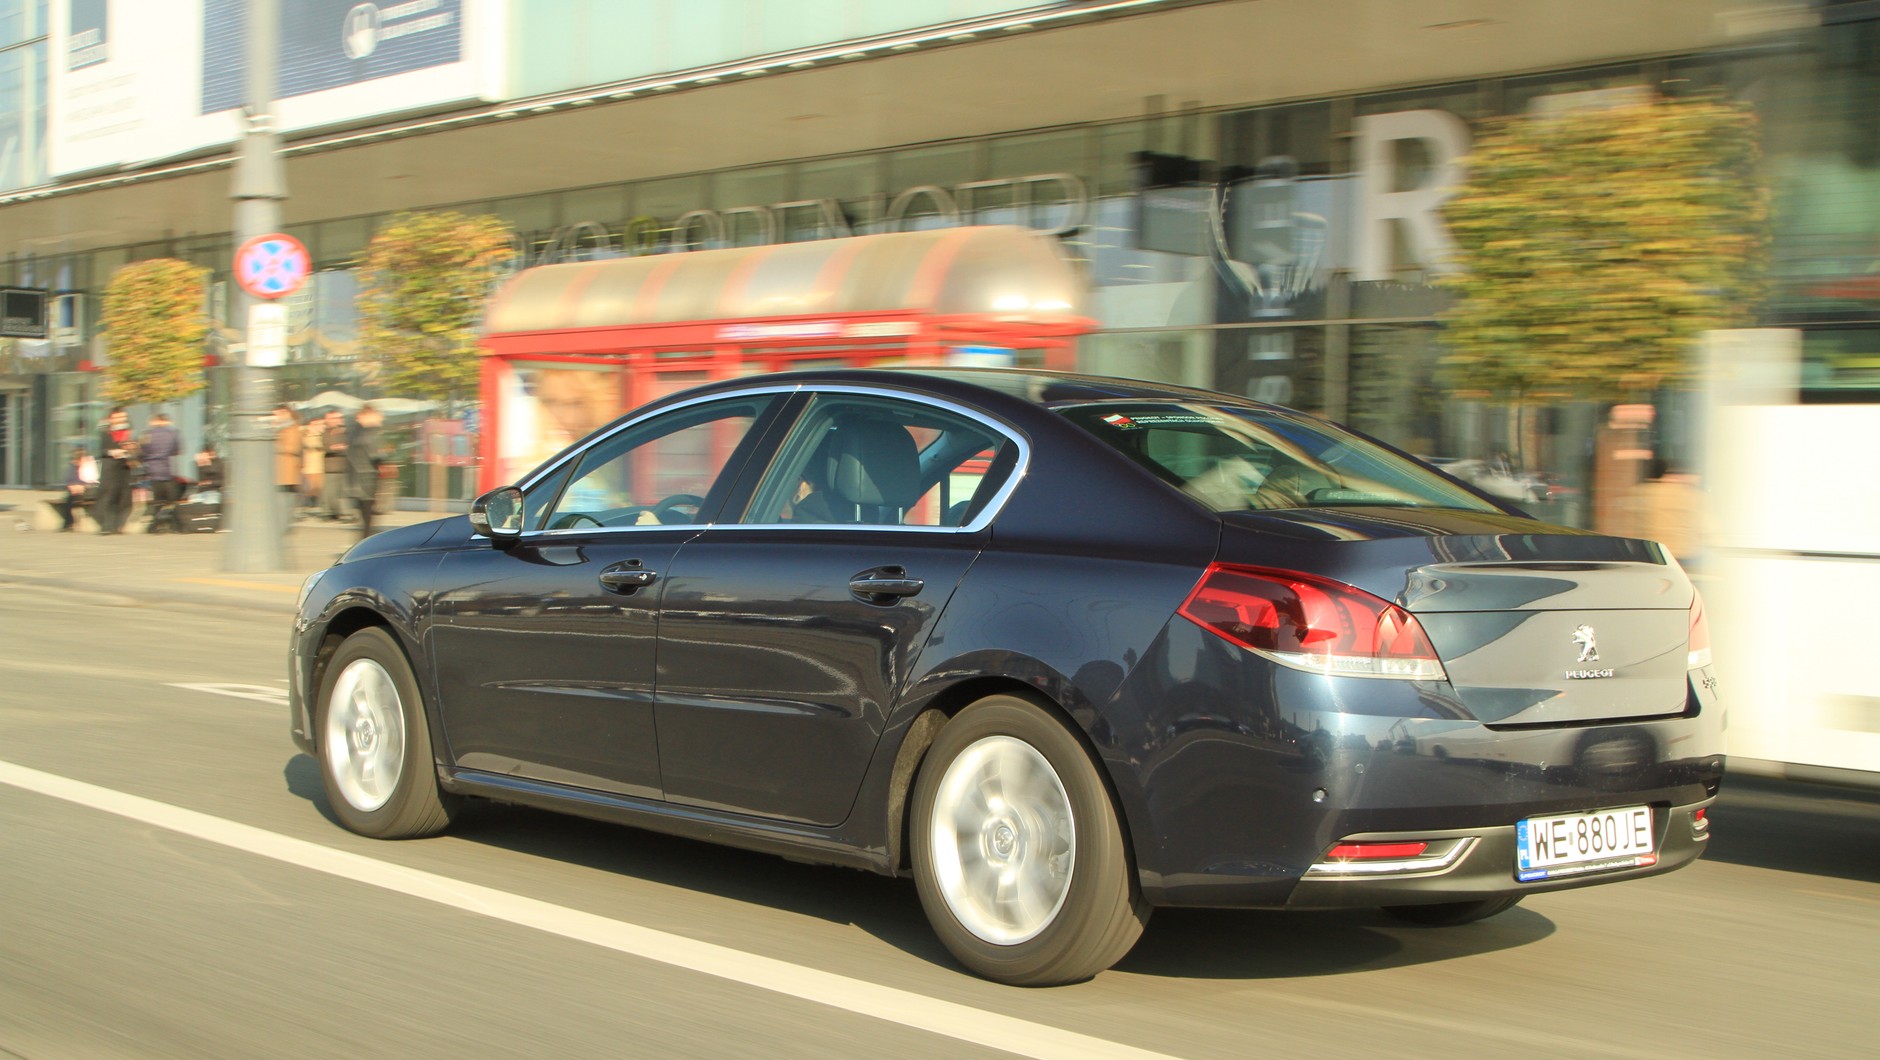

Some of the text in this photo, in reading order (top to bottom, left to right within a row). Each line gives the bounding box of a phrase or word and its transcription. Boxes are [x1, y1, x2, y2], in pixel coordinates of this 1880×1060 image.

[1565, 668, 1615, 680] PEUGEOT
[1533, 811, 1648, 861] WE 880JE
